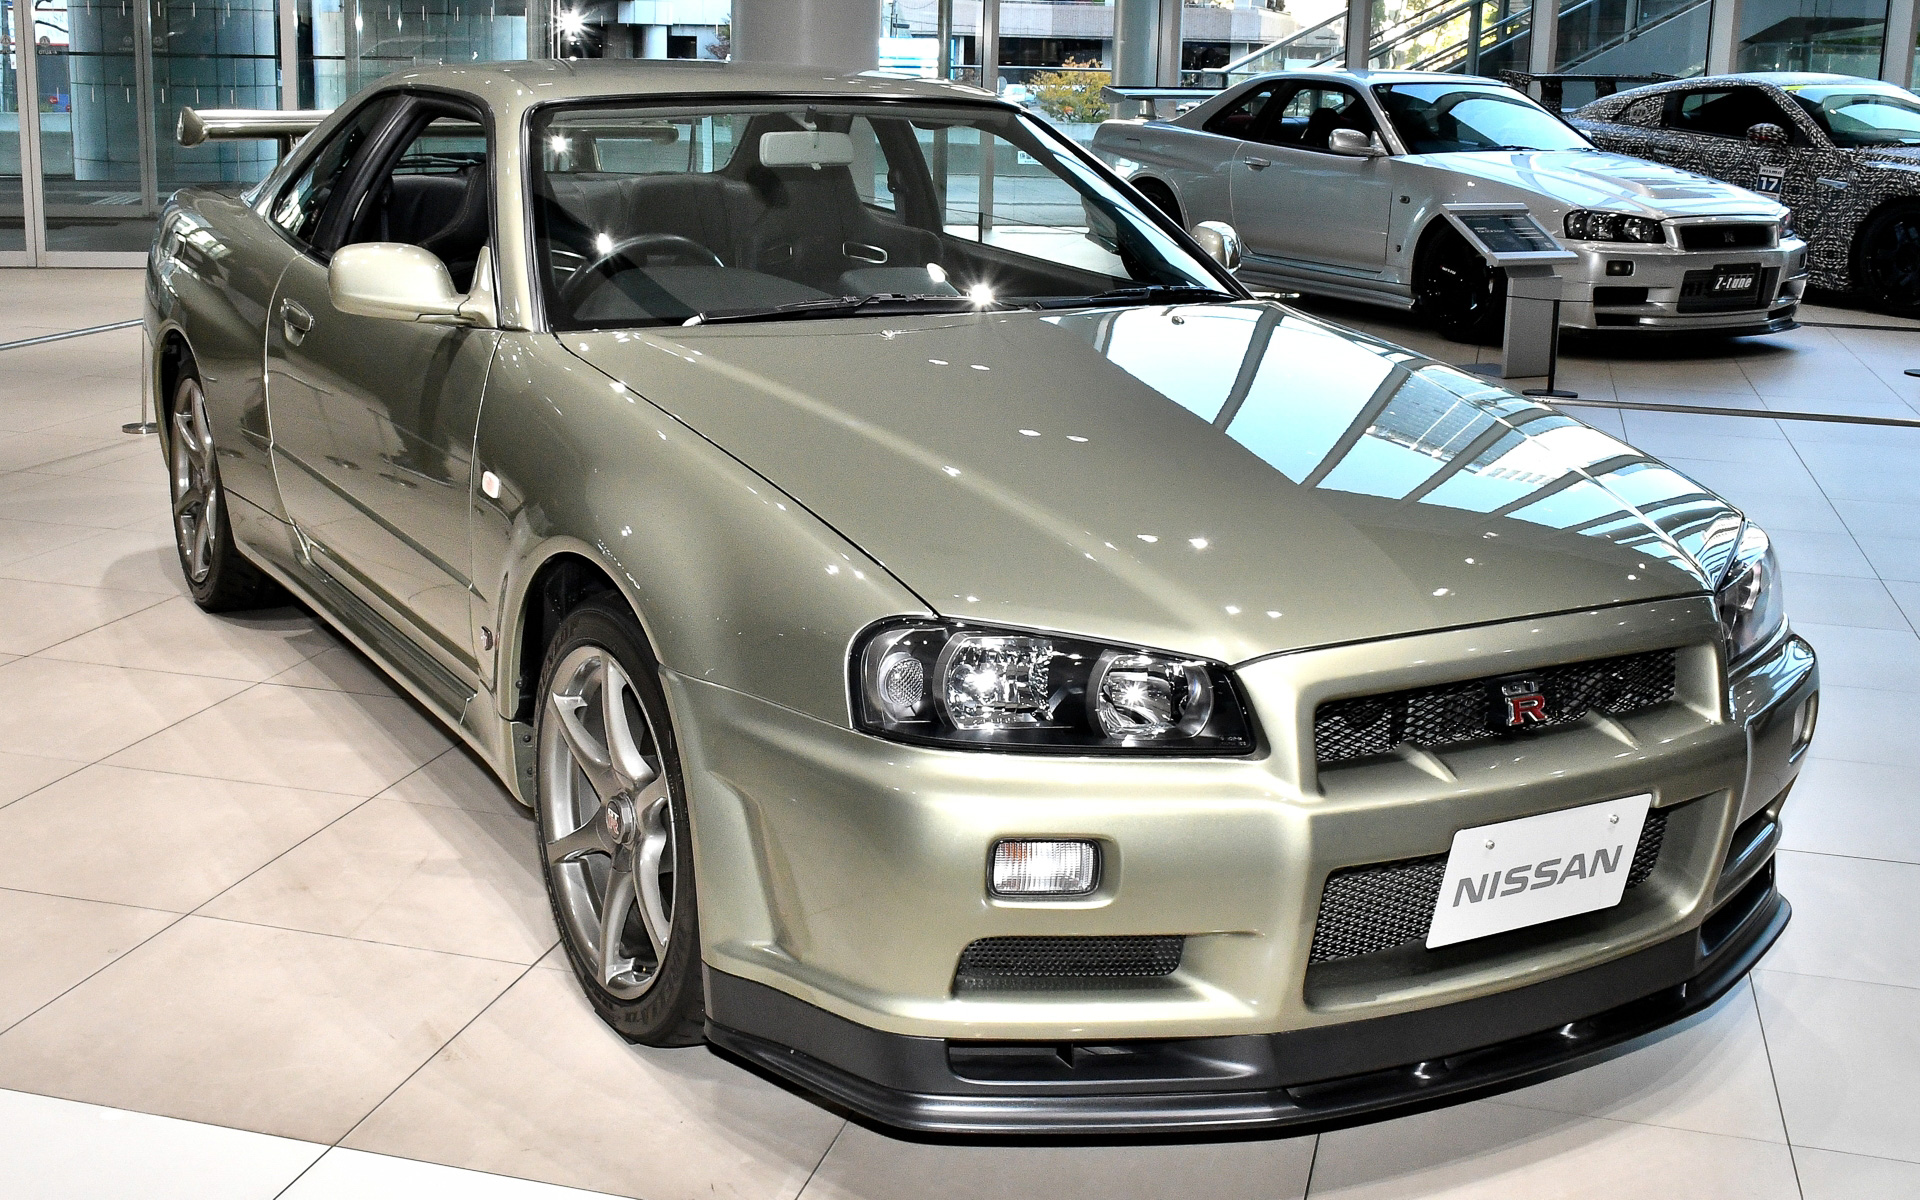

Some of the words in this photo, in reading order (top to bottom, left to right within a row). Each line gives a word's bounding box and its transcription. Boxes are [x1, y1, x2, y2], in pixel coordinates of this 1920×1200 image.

[1760, 177, 1778, 191] 17
[1714, 275, 1752, 290] Z-tune
[1452, 844, 1623, 908] NISSAN
